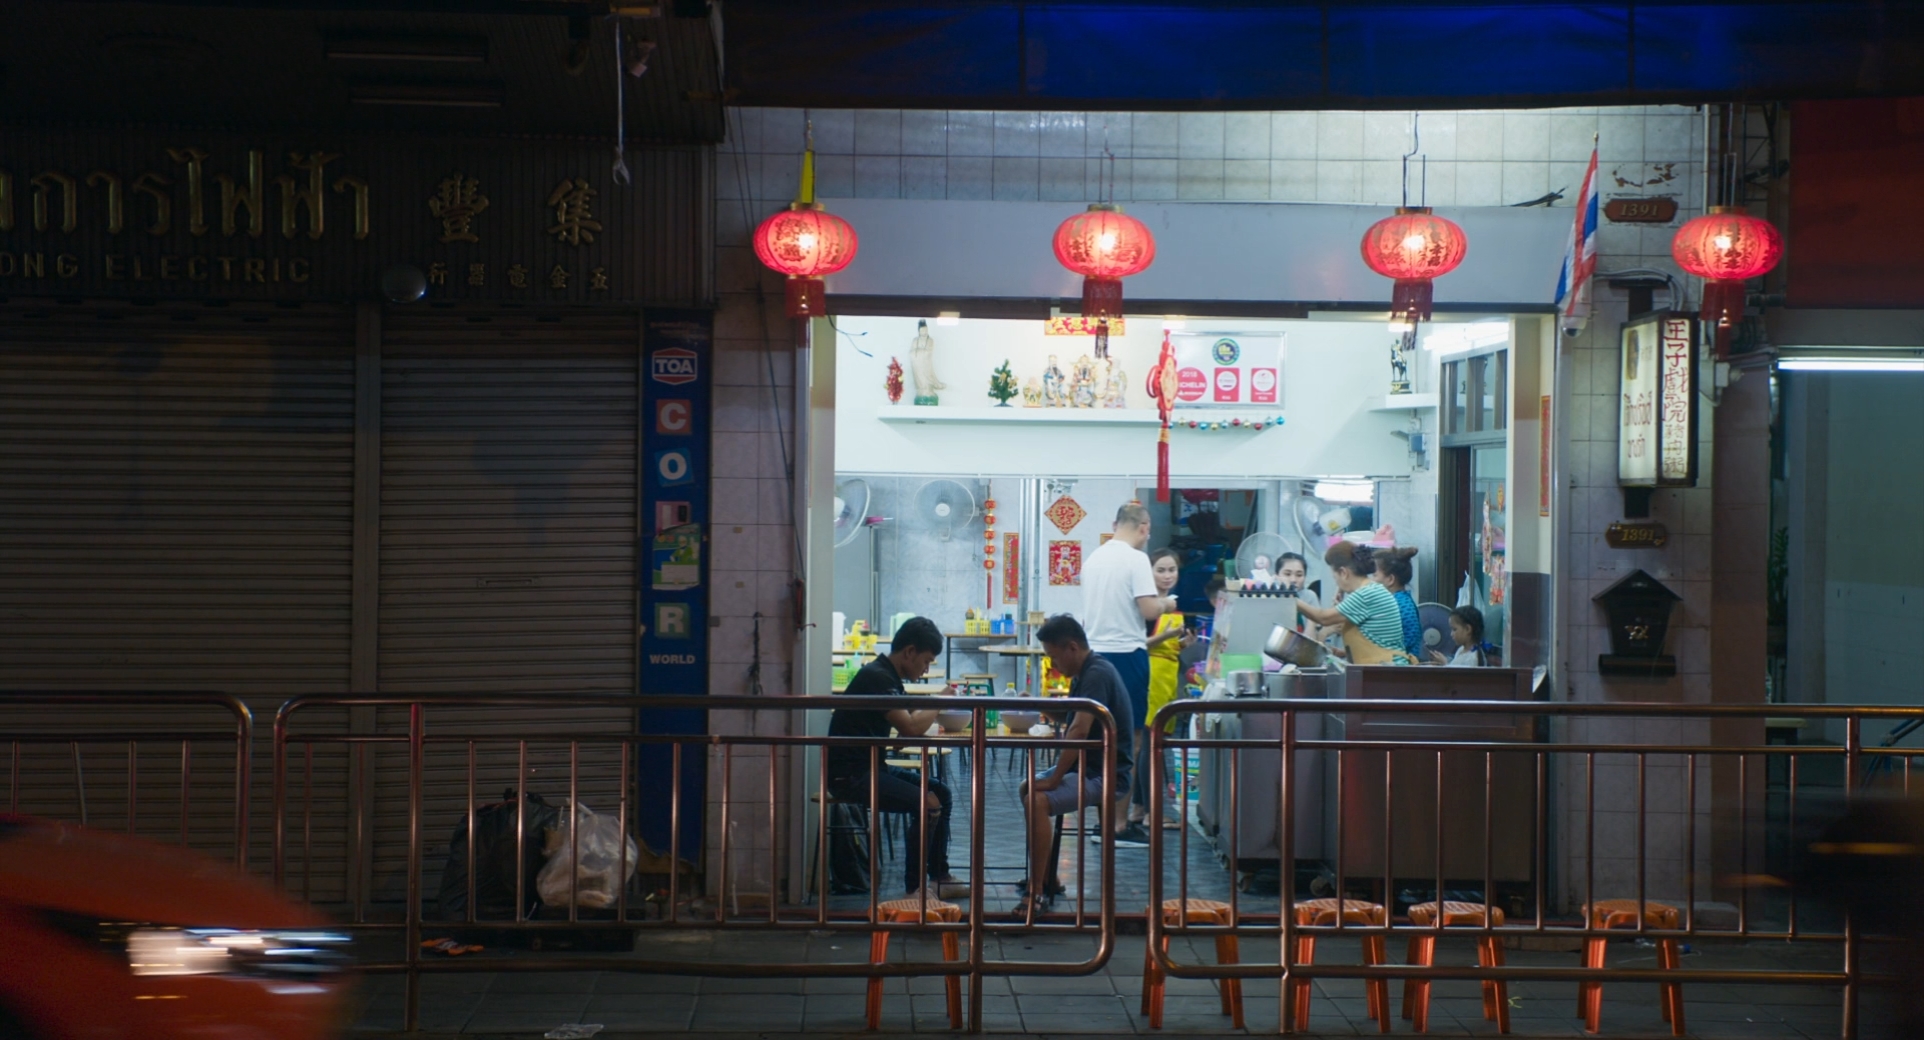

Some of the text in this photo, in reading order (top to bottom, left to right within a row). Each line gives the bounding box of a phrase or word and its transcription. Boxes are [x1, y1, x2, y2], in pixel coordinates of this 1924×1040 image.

[1620, 204, 1659, 217] 1391
[105, 254, 311, 283] ELECTRIC
[655, 358, 694, 374] TOA
[1621, 528, 1655, 542] 1391
[649, 653, 697, 665] WORLD
